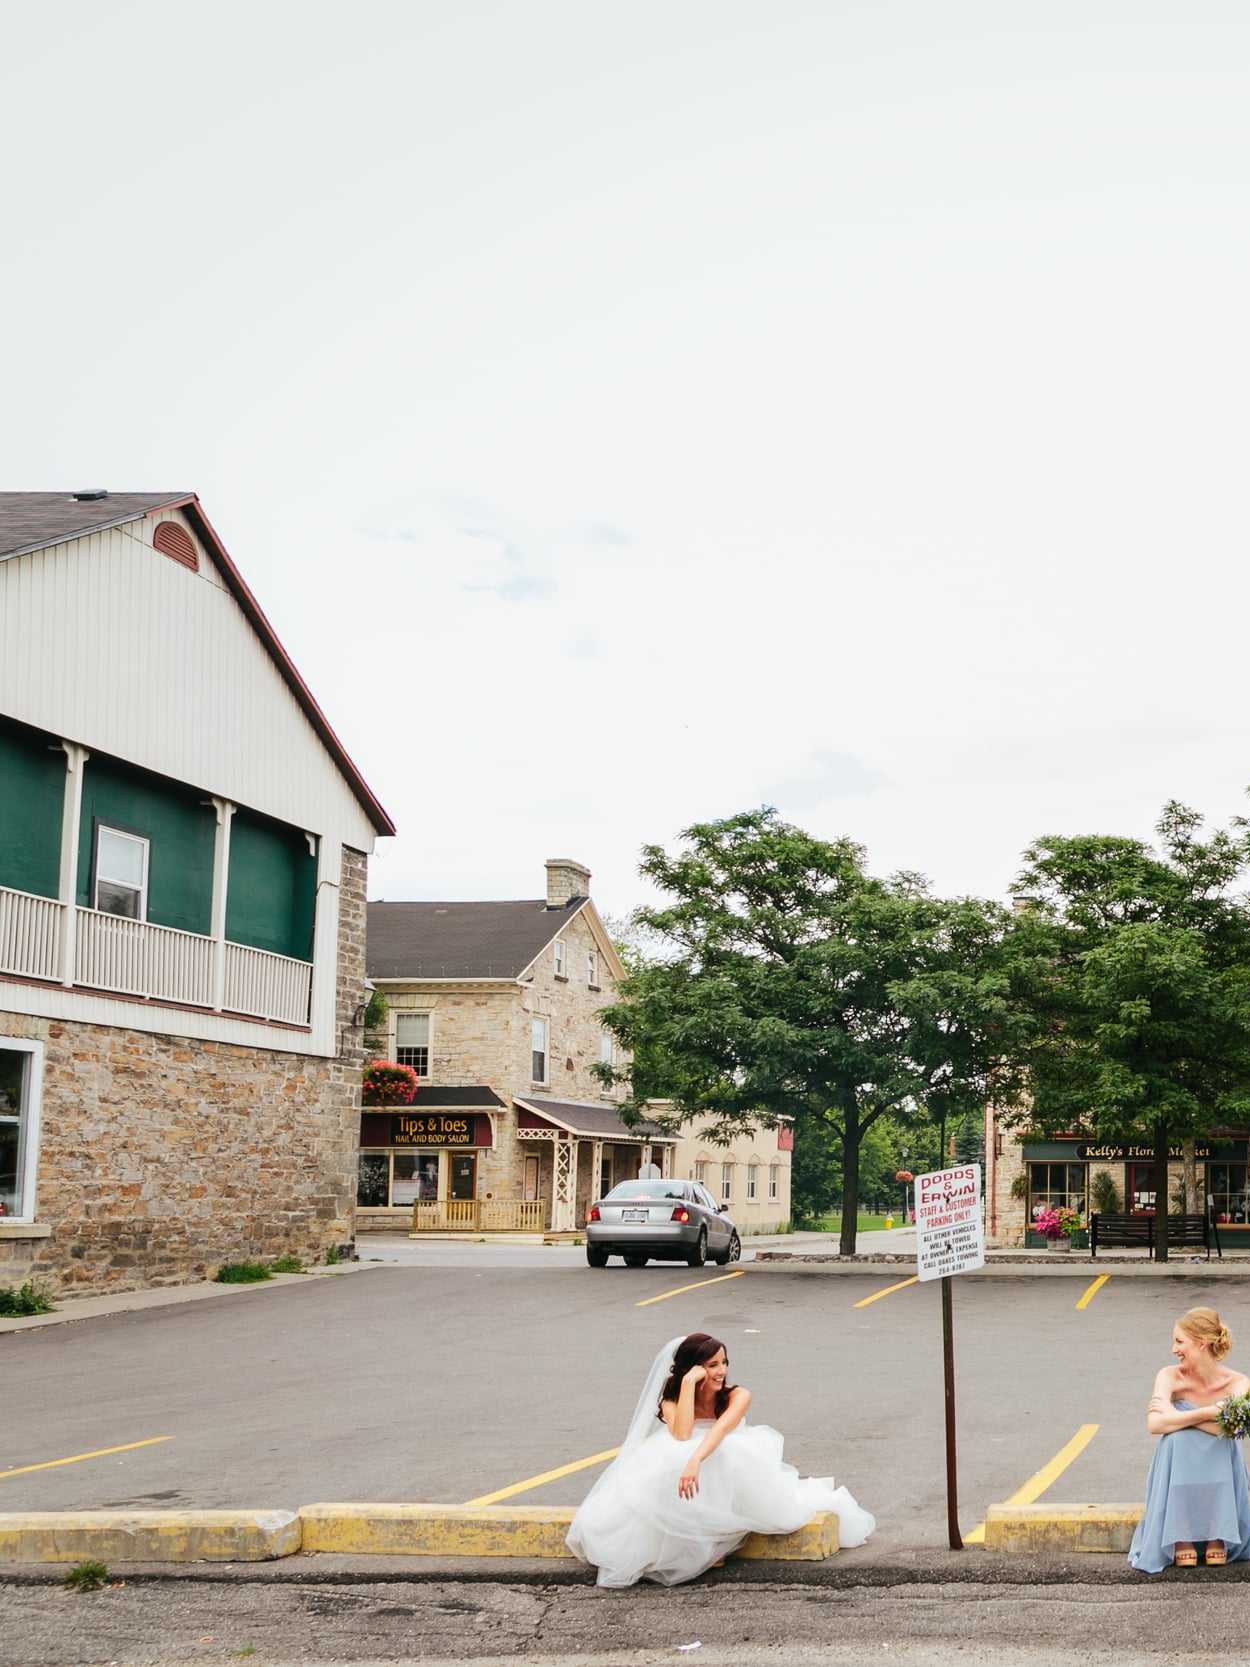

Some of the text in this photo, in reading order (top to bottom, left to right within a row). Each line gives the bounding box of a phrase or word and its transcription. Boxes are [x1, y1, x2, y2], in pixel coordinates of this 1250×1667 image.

[398, 1116, 467, 1136] Tips & Toes
[395, 1134, 469, 1143] NAIL AND BODY SALON
[1085, 1146, 1123, 1160] Kelly's
[921, 1168, 975, 1190] DODDS
[943, 1182, 952, 1190] &
[921, 1182, 975, 1204] ERWIN
[919, 1204, 937, 1218] STAFF
[945, 1196, 976, 1212] CUSTOMER
[926, 1210, 971, 1229] PARKING ONLY!
[934, 1230, 951, 1240] OTHER
[952, 1224, 976, 1236] VEHICLES
[929, 1241, 943, 1250] WILL
[952, 1235, 971, 1244] TOWED
[956, 1242, 978, 1253] EXPENSE
[923, 1261, 936, 1269] CALL
[957, 1251, 979, 1260] TOWING
